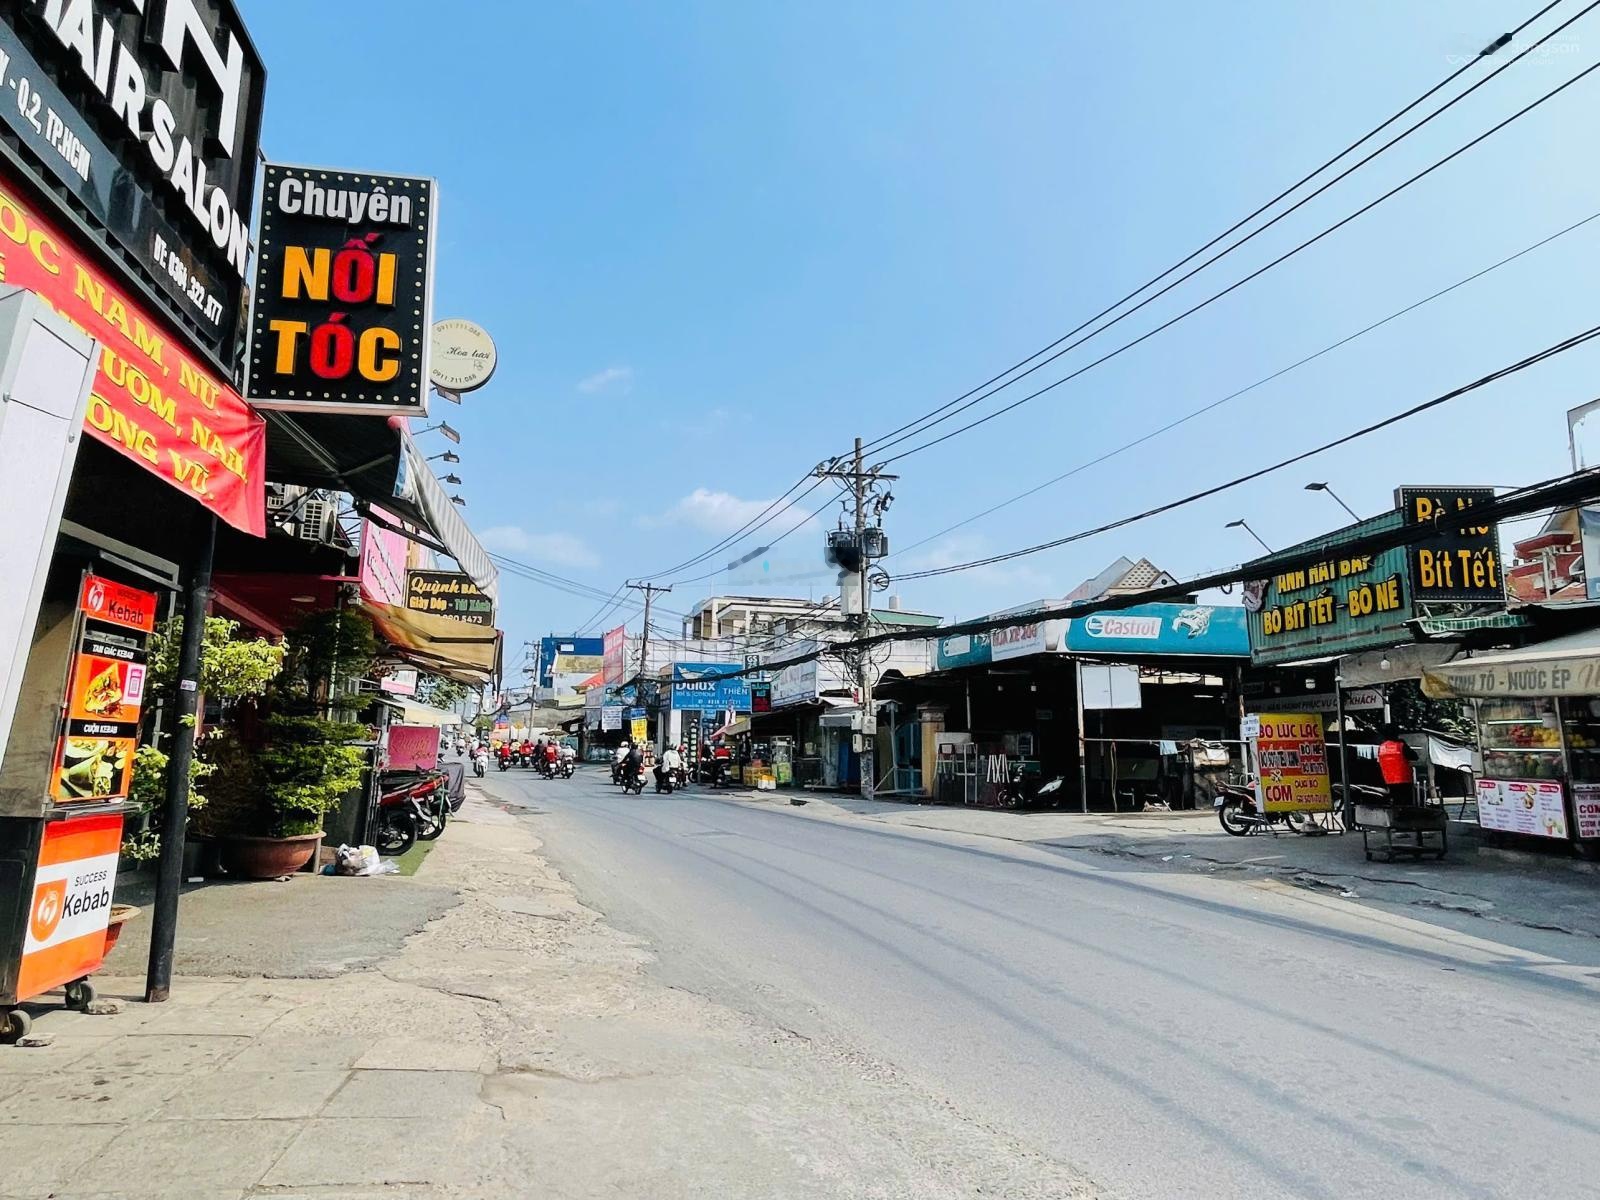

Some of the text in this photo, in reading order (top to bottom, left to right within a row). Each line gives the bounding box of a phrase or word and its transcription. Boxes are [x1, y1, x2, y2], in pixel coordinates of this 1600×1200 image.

[33, 0, 249, 280] AIR SALON
[278, 177, 412, 224] Chuyên
[282, 232, 397, 306] NỐI
[74, 263, 169, 377] NAM,
[269, 312, 401, 382] TÓC
[1420, 547, 1497, 588] Bít Tết
[108, 599, 144, 625] Kebab
[1104, 619, 1157, 635] Castrol
[1264, 605, 1281, 635] BÒ
[1284, 600, 1306, 631] BÍT
[1308, 588, 1333, 625] TẾT
[1349, 582, 1373, 617] BÒ
[1376, 575, 1399, 611] NÉ
[1552, 665, 1571, 689] ÉP
[75, 870, 107, 887] SUCCESS
[62, 886, 109, 919] Kebab
